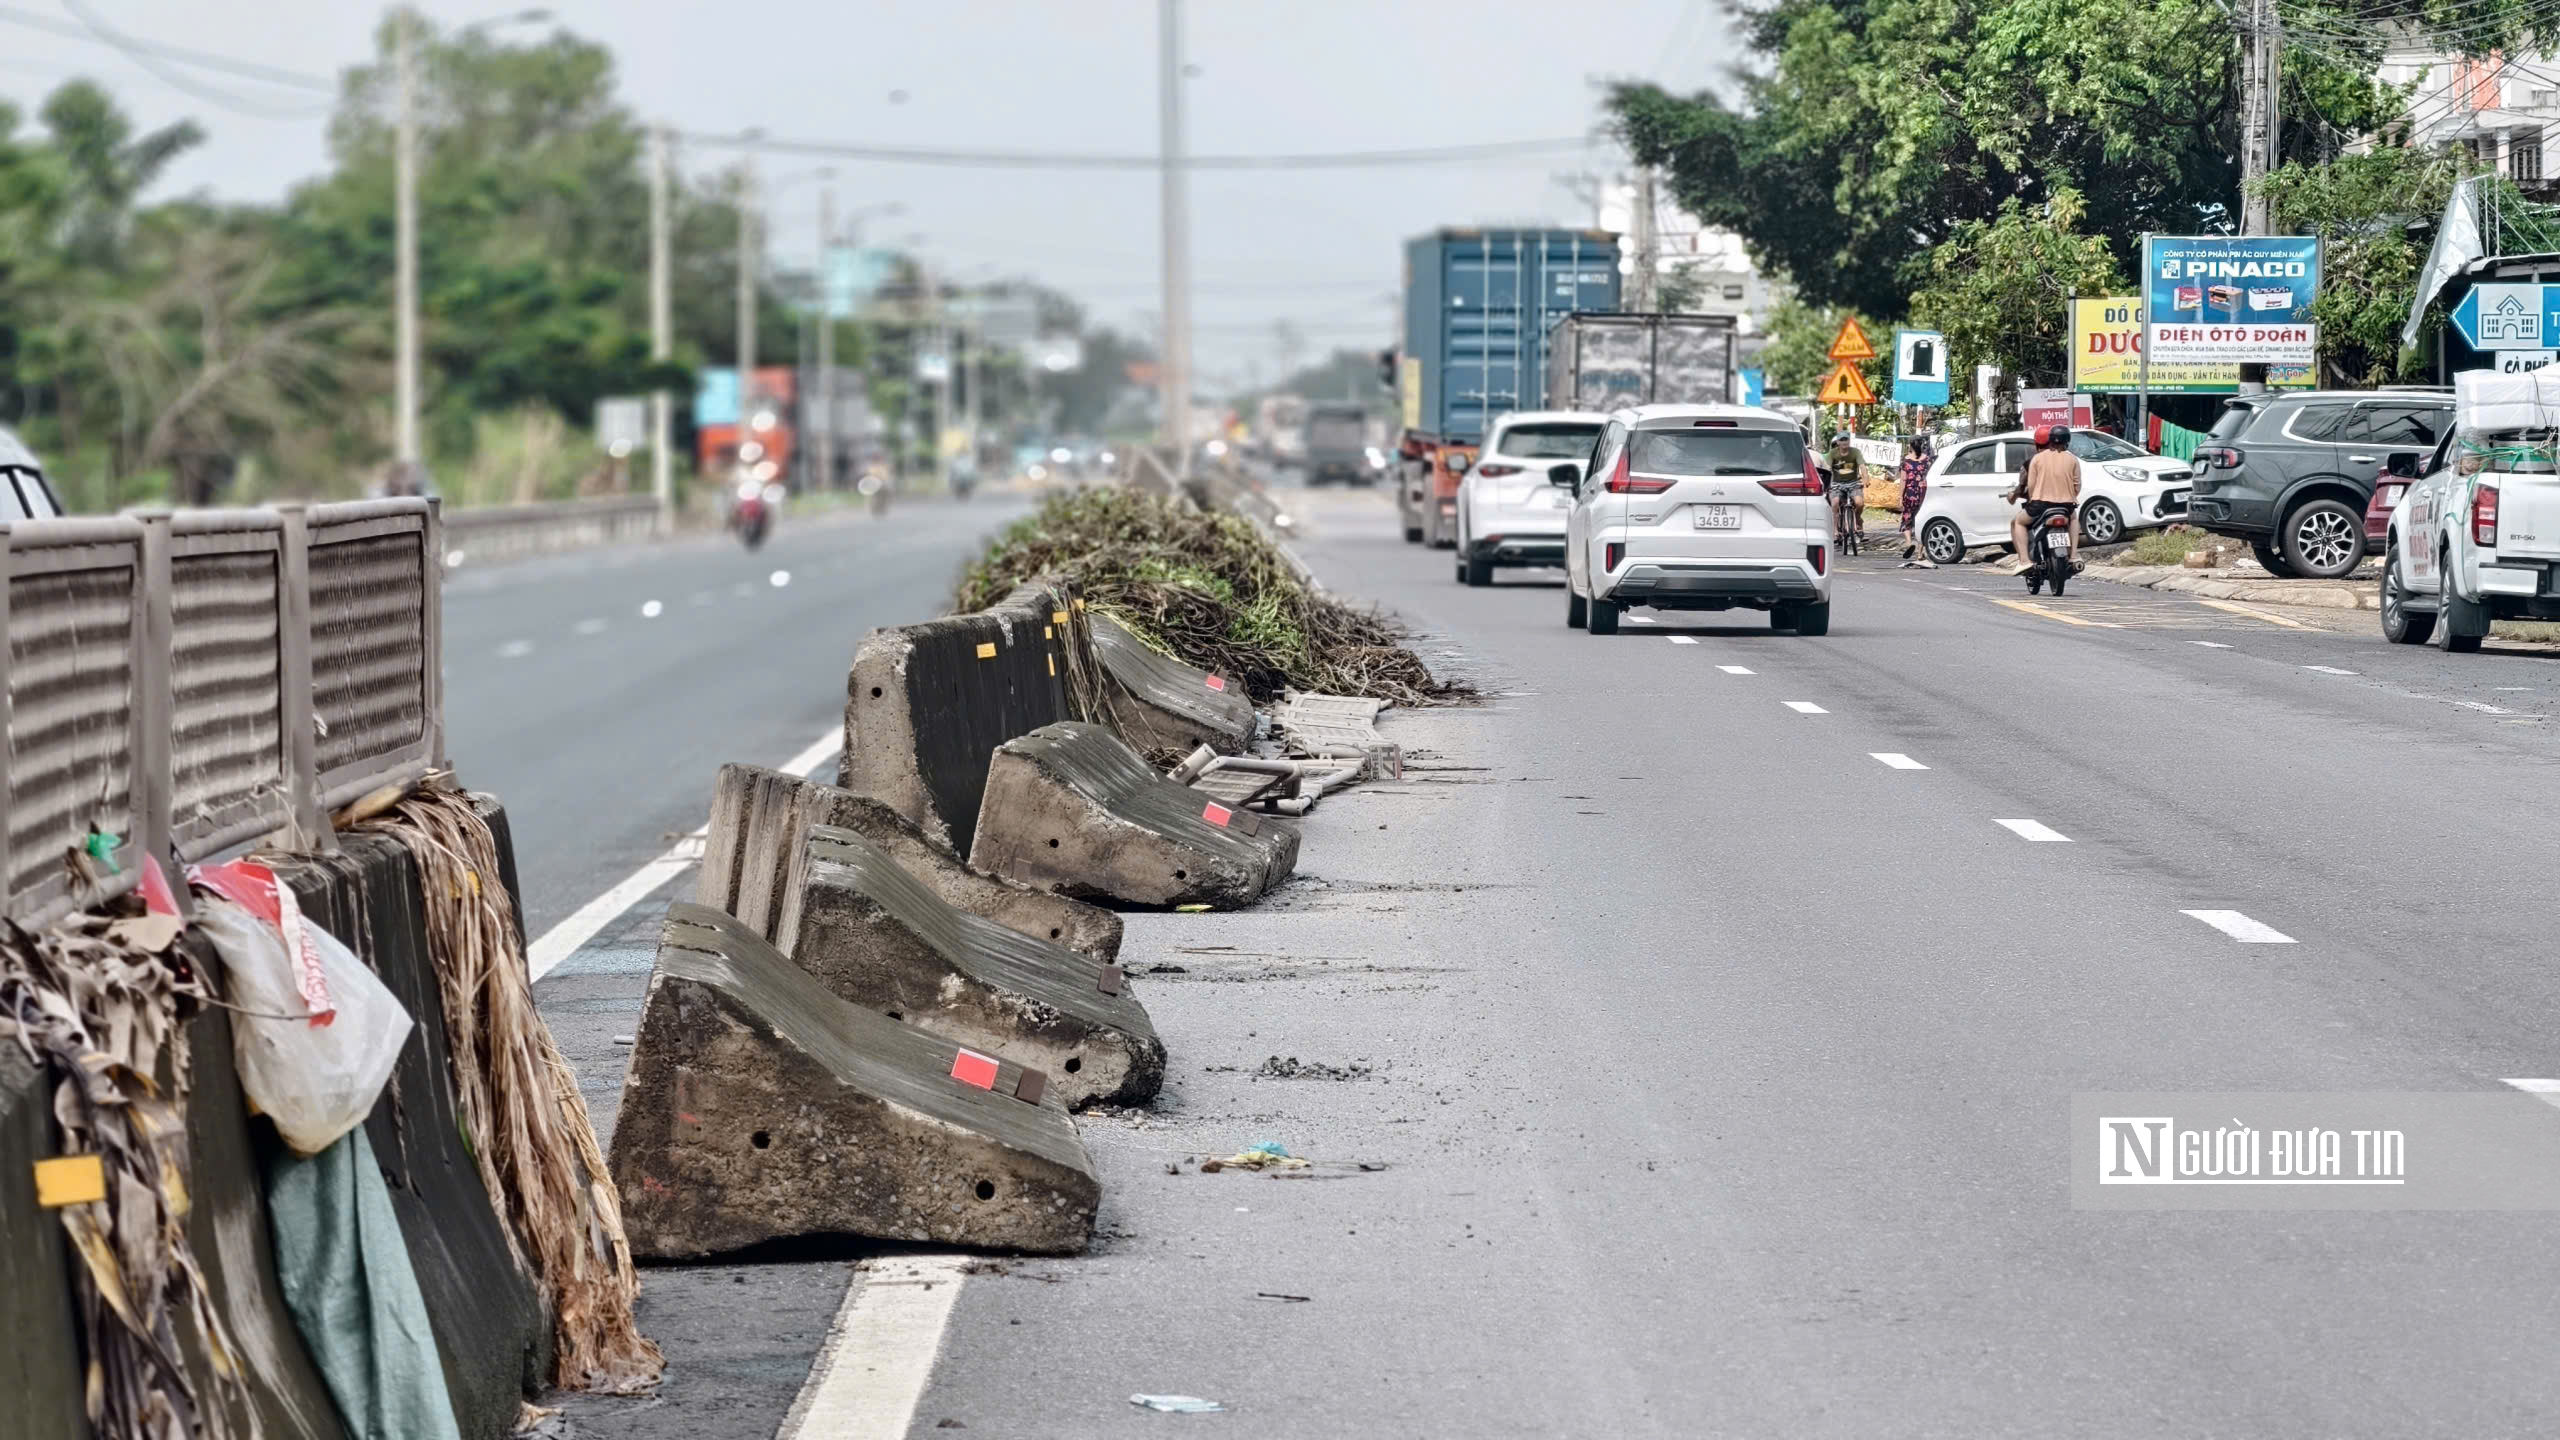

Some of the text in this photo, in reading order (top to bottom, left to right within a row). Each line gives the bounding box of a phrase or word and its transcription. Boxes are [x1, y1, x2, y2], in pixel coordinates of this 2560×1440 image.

[2185, 250, 2195, 258] TY
[2228, 250, 2241, 258] PIN
[2186, 261, 2305, 278] PINACO
[2105, 302, 2129, 323] ĐỒ
[2159, 326, 2307, 344] ĐIỆN ÔTÔ ĐOÀN
[2055, 409, 2069, 420] THẤ
[1707, 506, 1728, 516] 79A
[1699, 516, 1736, 527] 349.87
